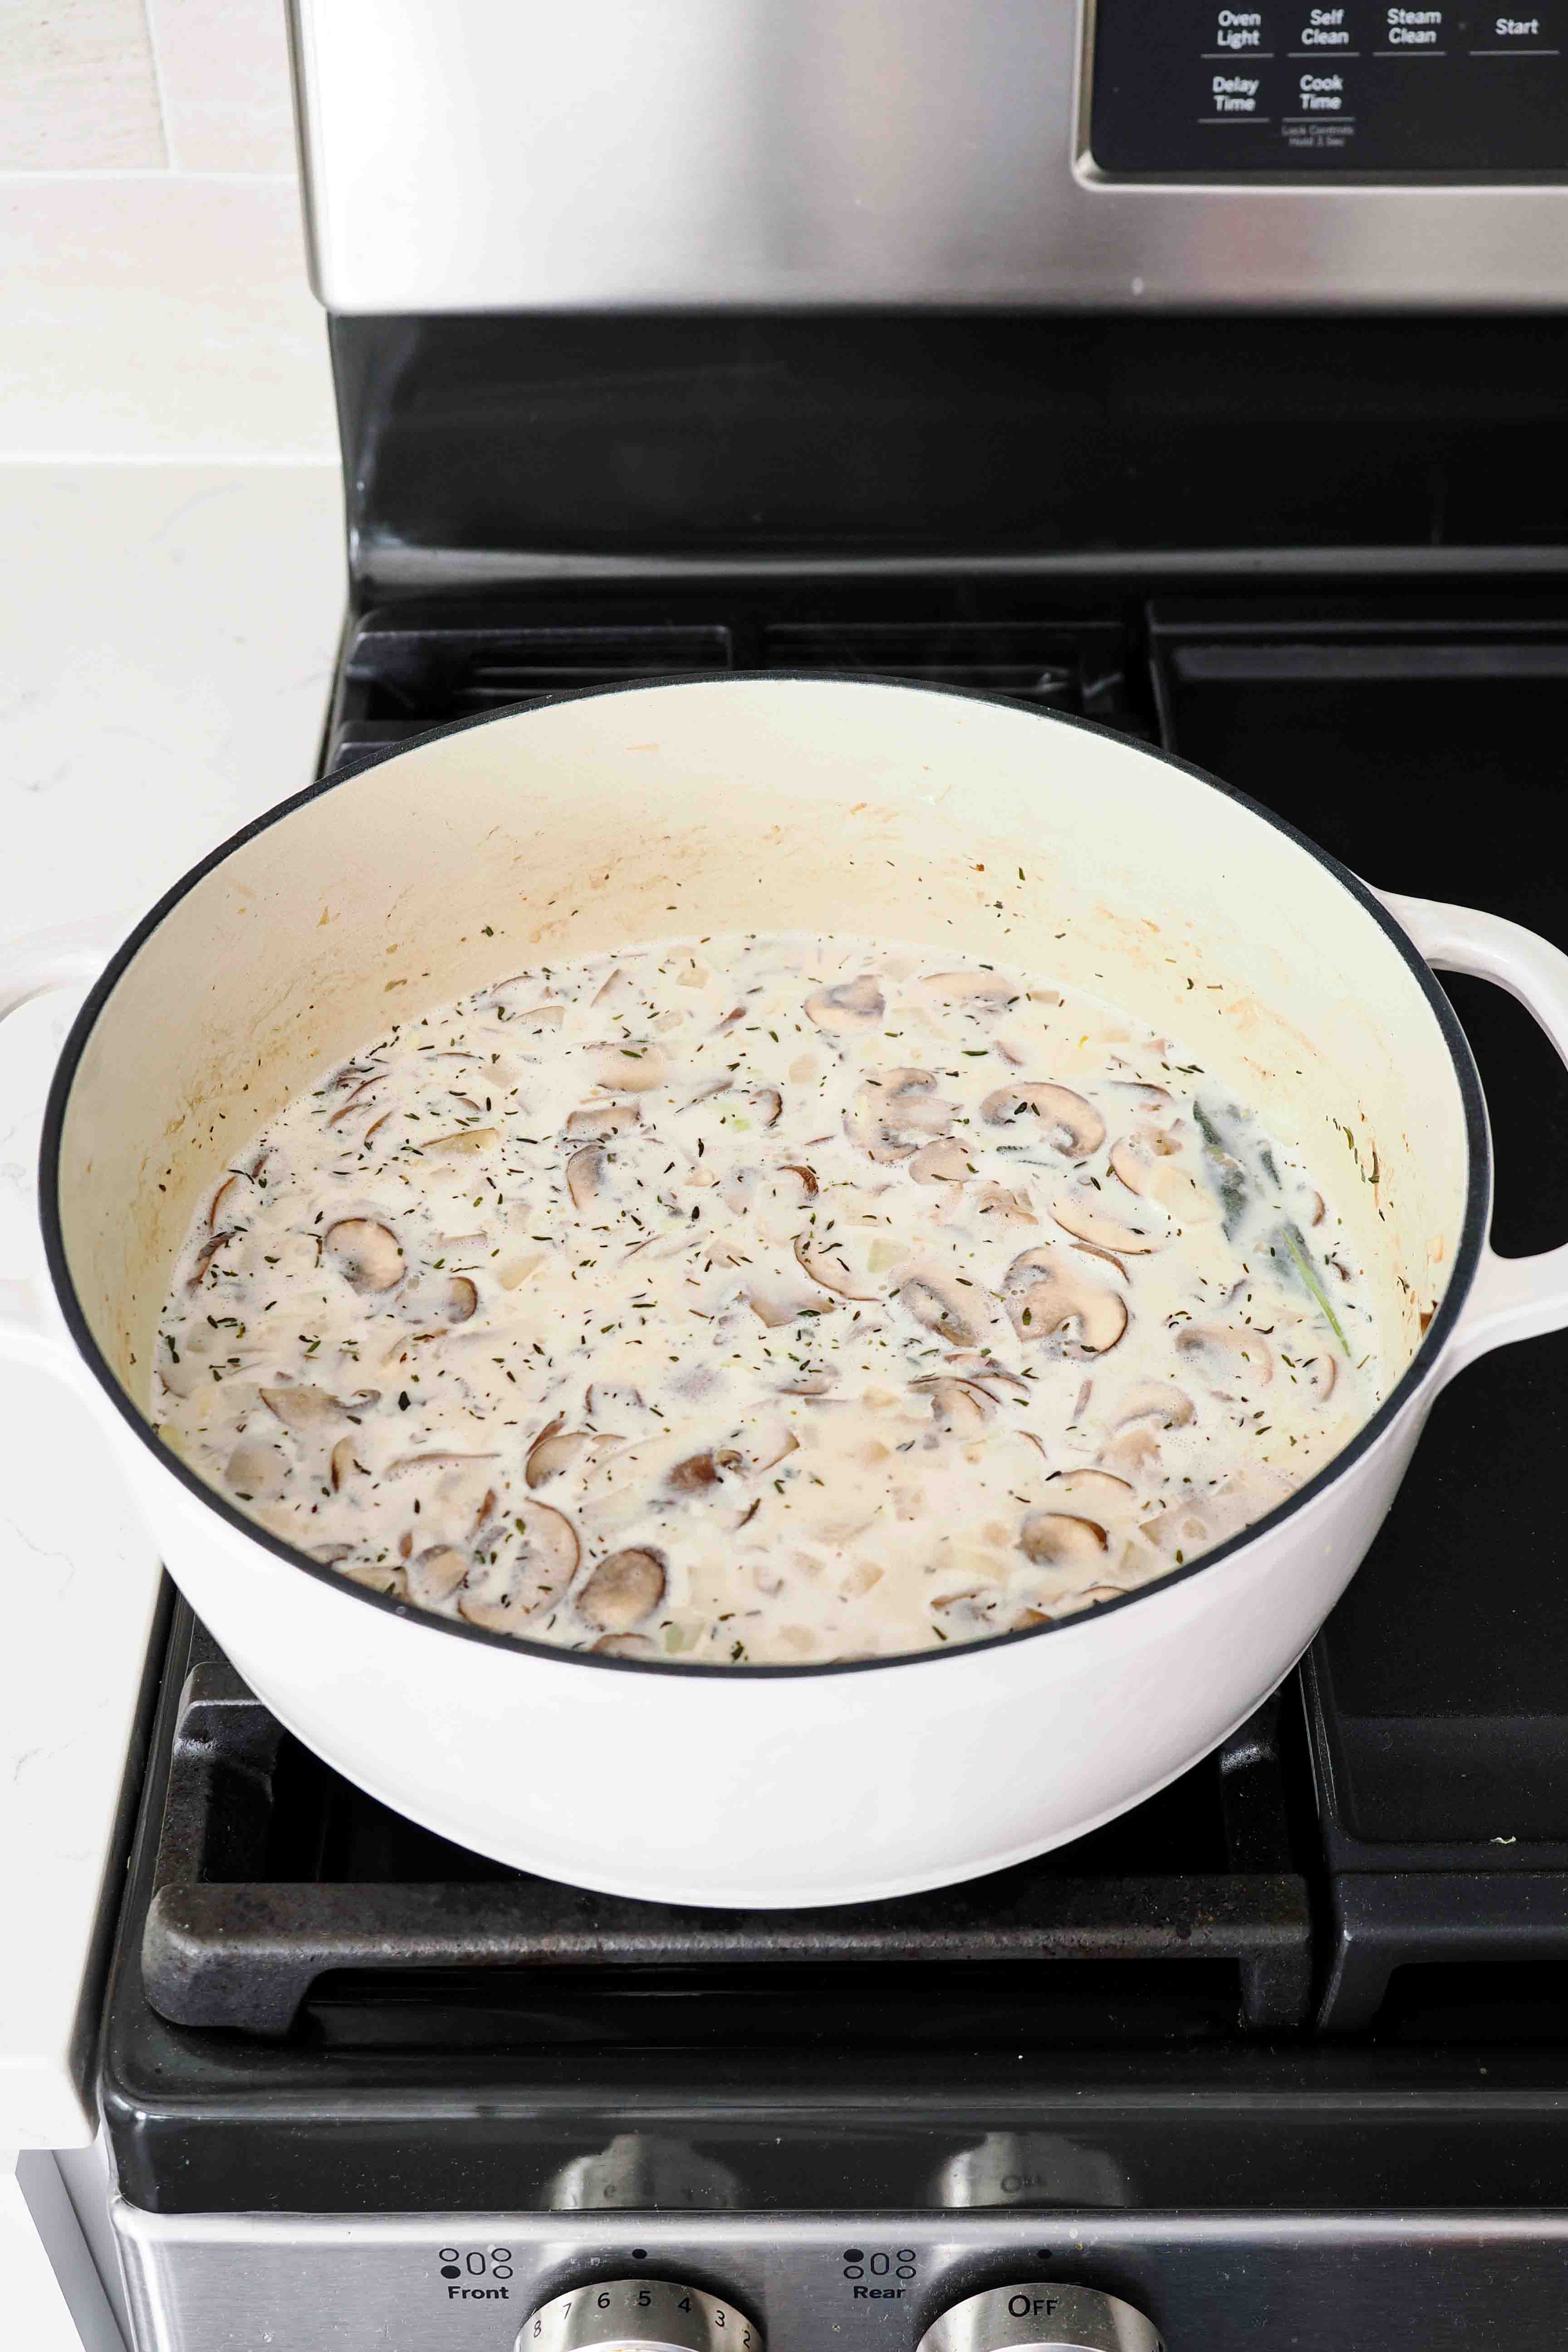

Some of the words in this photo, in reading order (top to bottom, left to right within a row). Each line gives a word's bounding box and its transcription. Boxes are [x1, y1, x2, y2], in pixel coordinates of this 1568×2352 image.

[1218, 10, 1261, 26] Oven
[1310, 9, 1344, 25] Self
[1385, 8, 1442, 24] Steam
[1495, 18, 1539, 34] Start
[1217, 30, 1260, 49] Light
[1301, 28, 1349, 45] Clean
[1388, 27, 1437, 44] Clean
[1212, 76, 1259, 95] Delay
[1299, 74, 1343, 91] Cook
[1213, 95, 1256, 111] Time
[1299, 93, 1342, 110] Time
[448, 2286, 509, 2299] Front
[853, 2286, 906, 2299] Rear
[1008, 2294, 1058, 2317] OFF
[534, 2320, 541, 2337] 8
[563, 2302, 572, 2319] 7
[598, 2293, 610, 2308] 6
[638, 2291, 651, 2307] 5
[678, 2298, 692, 2313] 4
[715, 2310, 725, 2327] 3
[743, 2330, 751, 2348] 2
